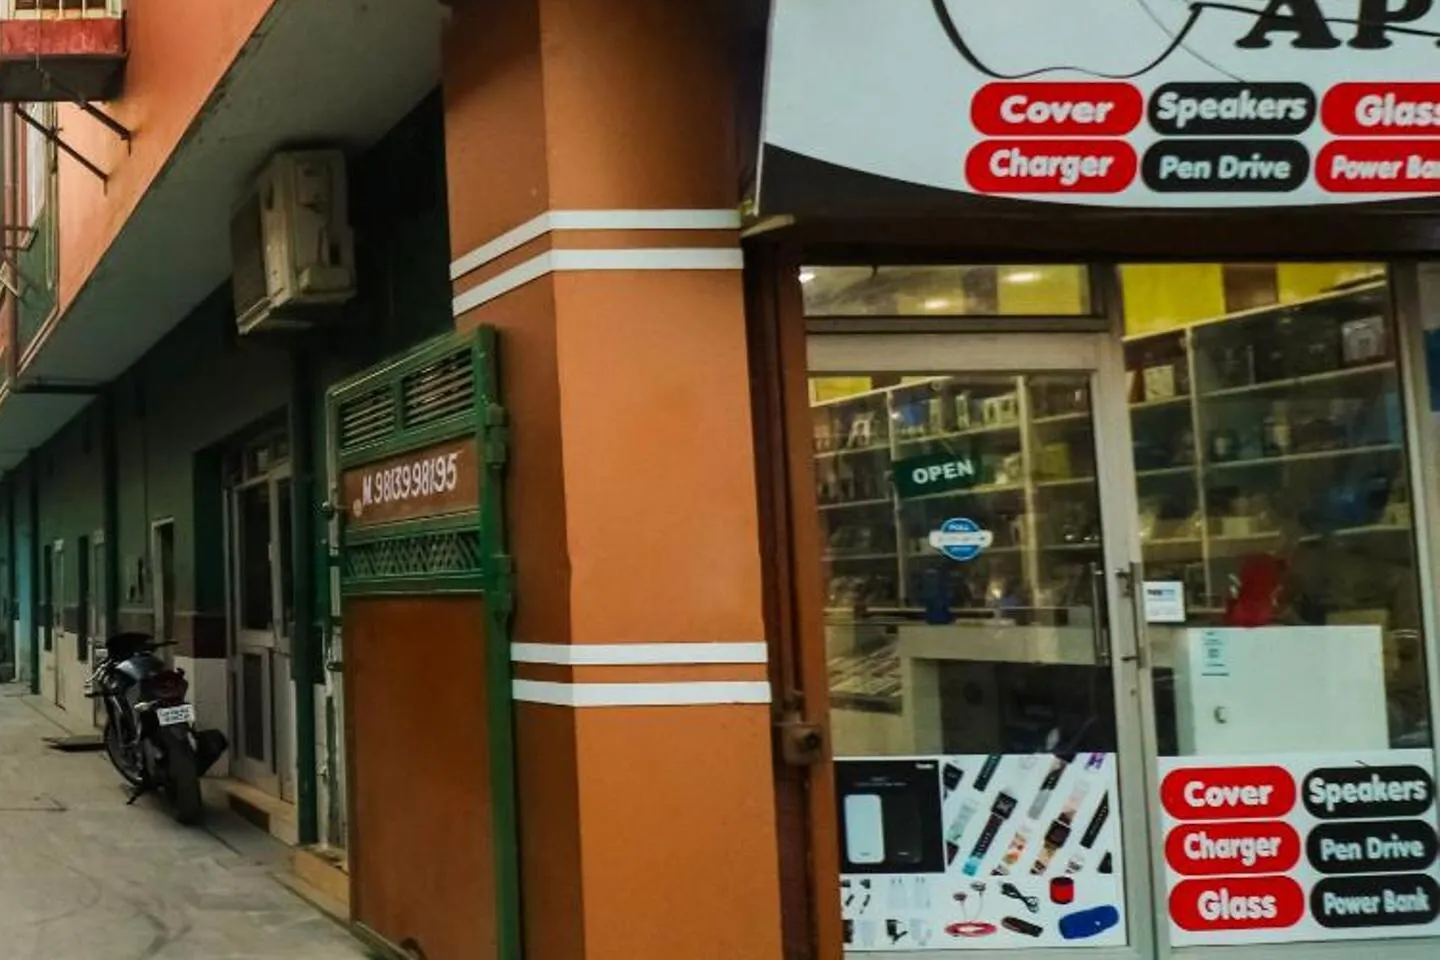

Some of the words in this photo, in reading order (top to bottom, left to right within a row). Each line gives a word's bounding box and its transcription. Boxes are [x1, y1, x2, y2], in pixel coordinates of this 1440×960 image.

[1000, 95, 1114, 123] Cover
[1157, 91, 1308, 128] Speakers
[989, 149, 1115, 184] Charger
[1160, 155, 1211, 180] Pen
[1218, 153, 1293, 180] Drive
[1331, 154, 1403, 180] Power
[912, 459, 975, 485] OPEN
[1184, 781, 1274, 807] Cover
[1309, 774, 1428, 812] Speakers
[1184, 831, 1282, 867] Charger
[1320, 838, 1361, 861] Pen
[1367, 834, 1425, 859] Drive
[1197, 888, 1278, 920] Glass
[1323, 892, 1379, 916] Power
[1383, 887, 1430, 913] Bank
